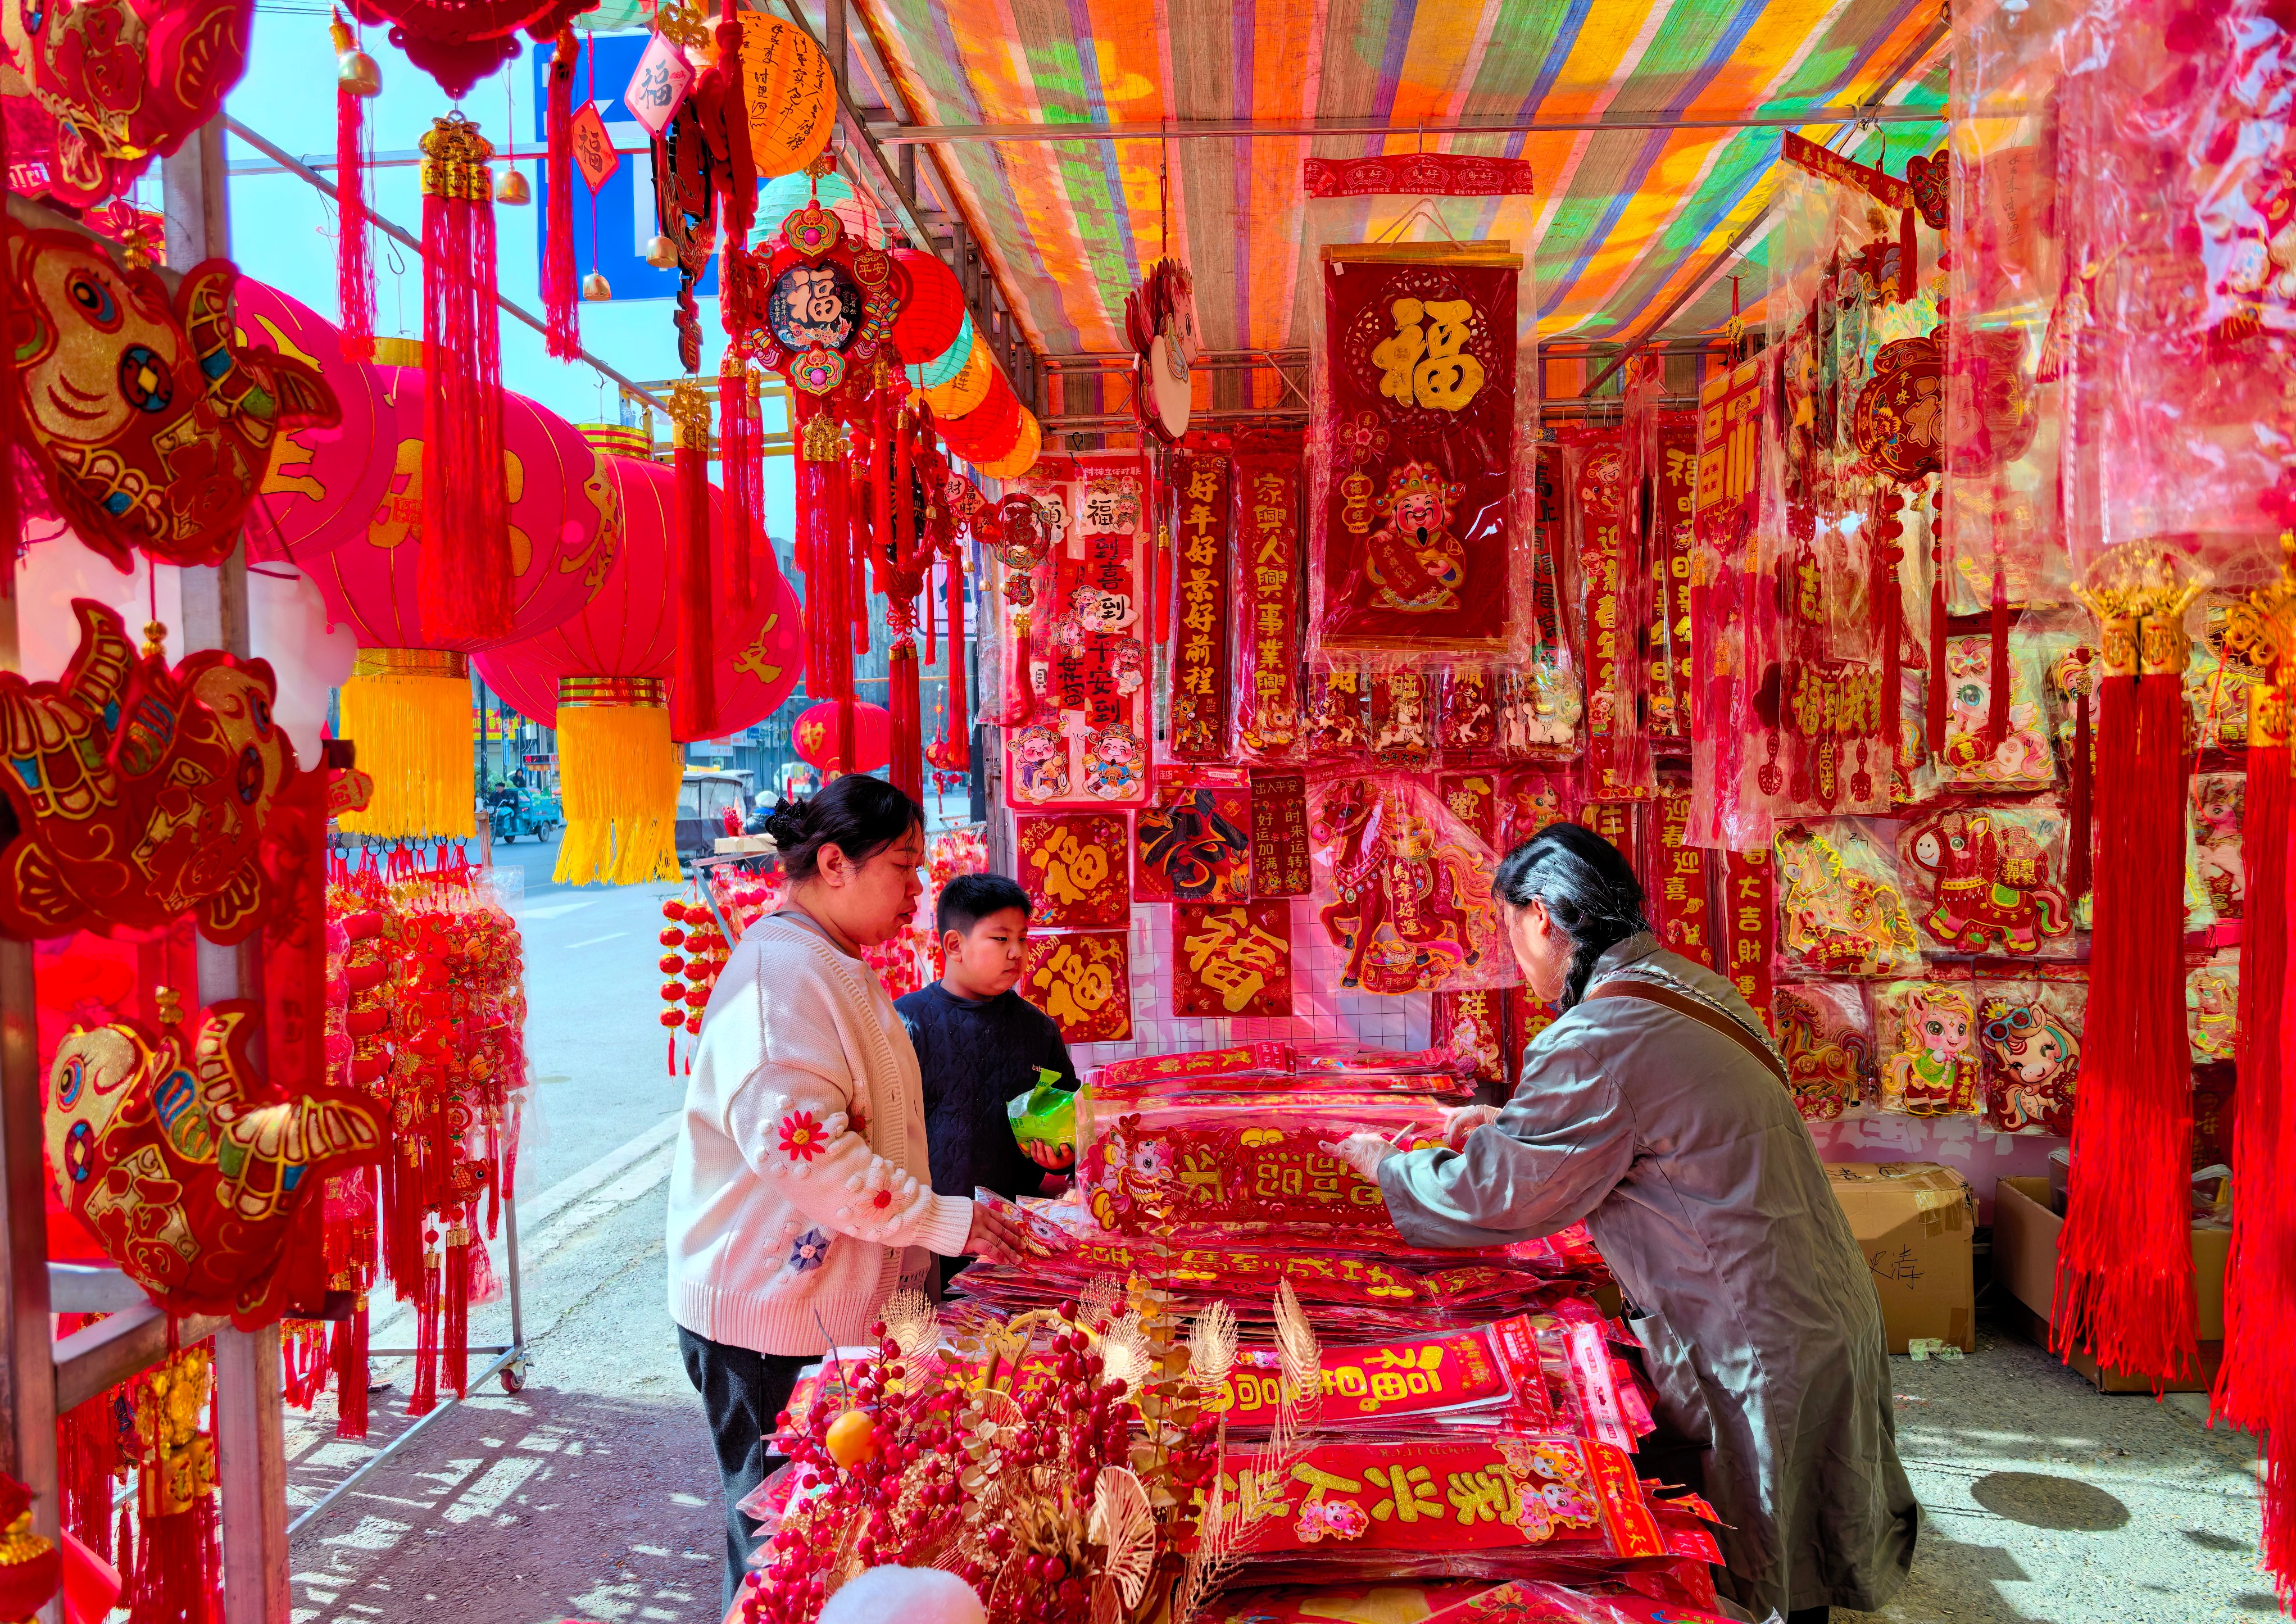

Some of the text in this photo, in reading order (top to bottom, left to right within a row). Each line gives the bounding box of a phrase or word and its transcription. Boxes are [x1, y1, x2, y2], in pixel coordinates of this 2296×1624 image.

[639, 60, 673, 110] 福
[578, 121, 603, 173] 福
[787, 268, 842, 323] 福
[859, 262, 886, 278] 平安
[1372, 297, 1485, 412] 福
[1894, 370, 1911, 405] 平安
[947, 480, 963, 495] 財
[1350, 482, 1364, 521] 福 旺
[1182, 471, 1219, 695] 好年好景好前程
[1253, 474, 1287, 702] 家興人興事業興
[1389, 674, 1421, 699] 旺
[1255, 779, 1298, 795] 出入平安
[1031, 826, 1109, 905] 福
[1256, 813, 1278, 870] 好运加满
[1285, 810, 1305, 869] 时来运转
[1408, 842, 1424, 857] 福
[1391, 863, 1423, 936] 馬年好運
[1818, 940, 1870, 964] 平安喜乐
[1033, 945, 1113, 1027] 福
